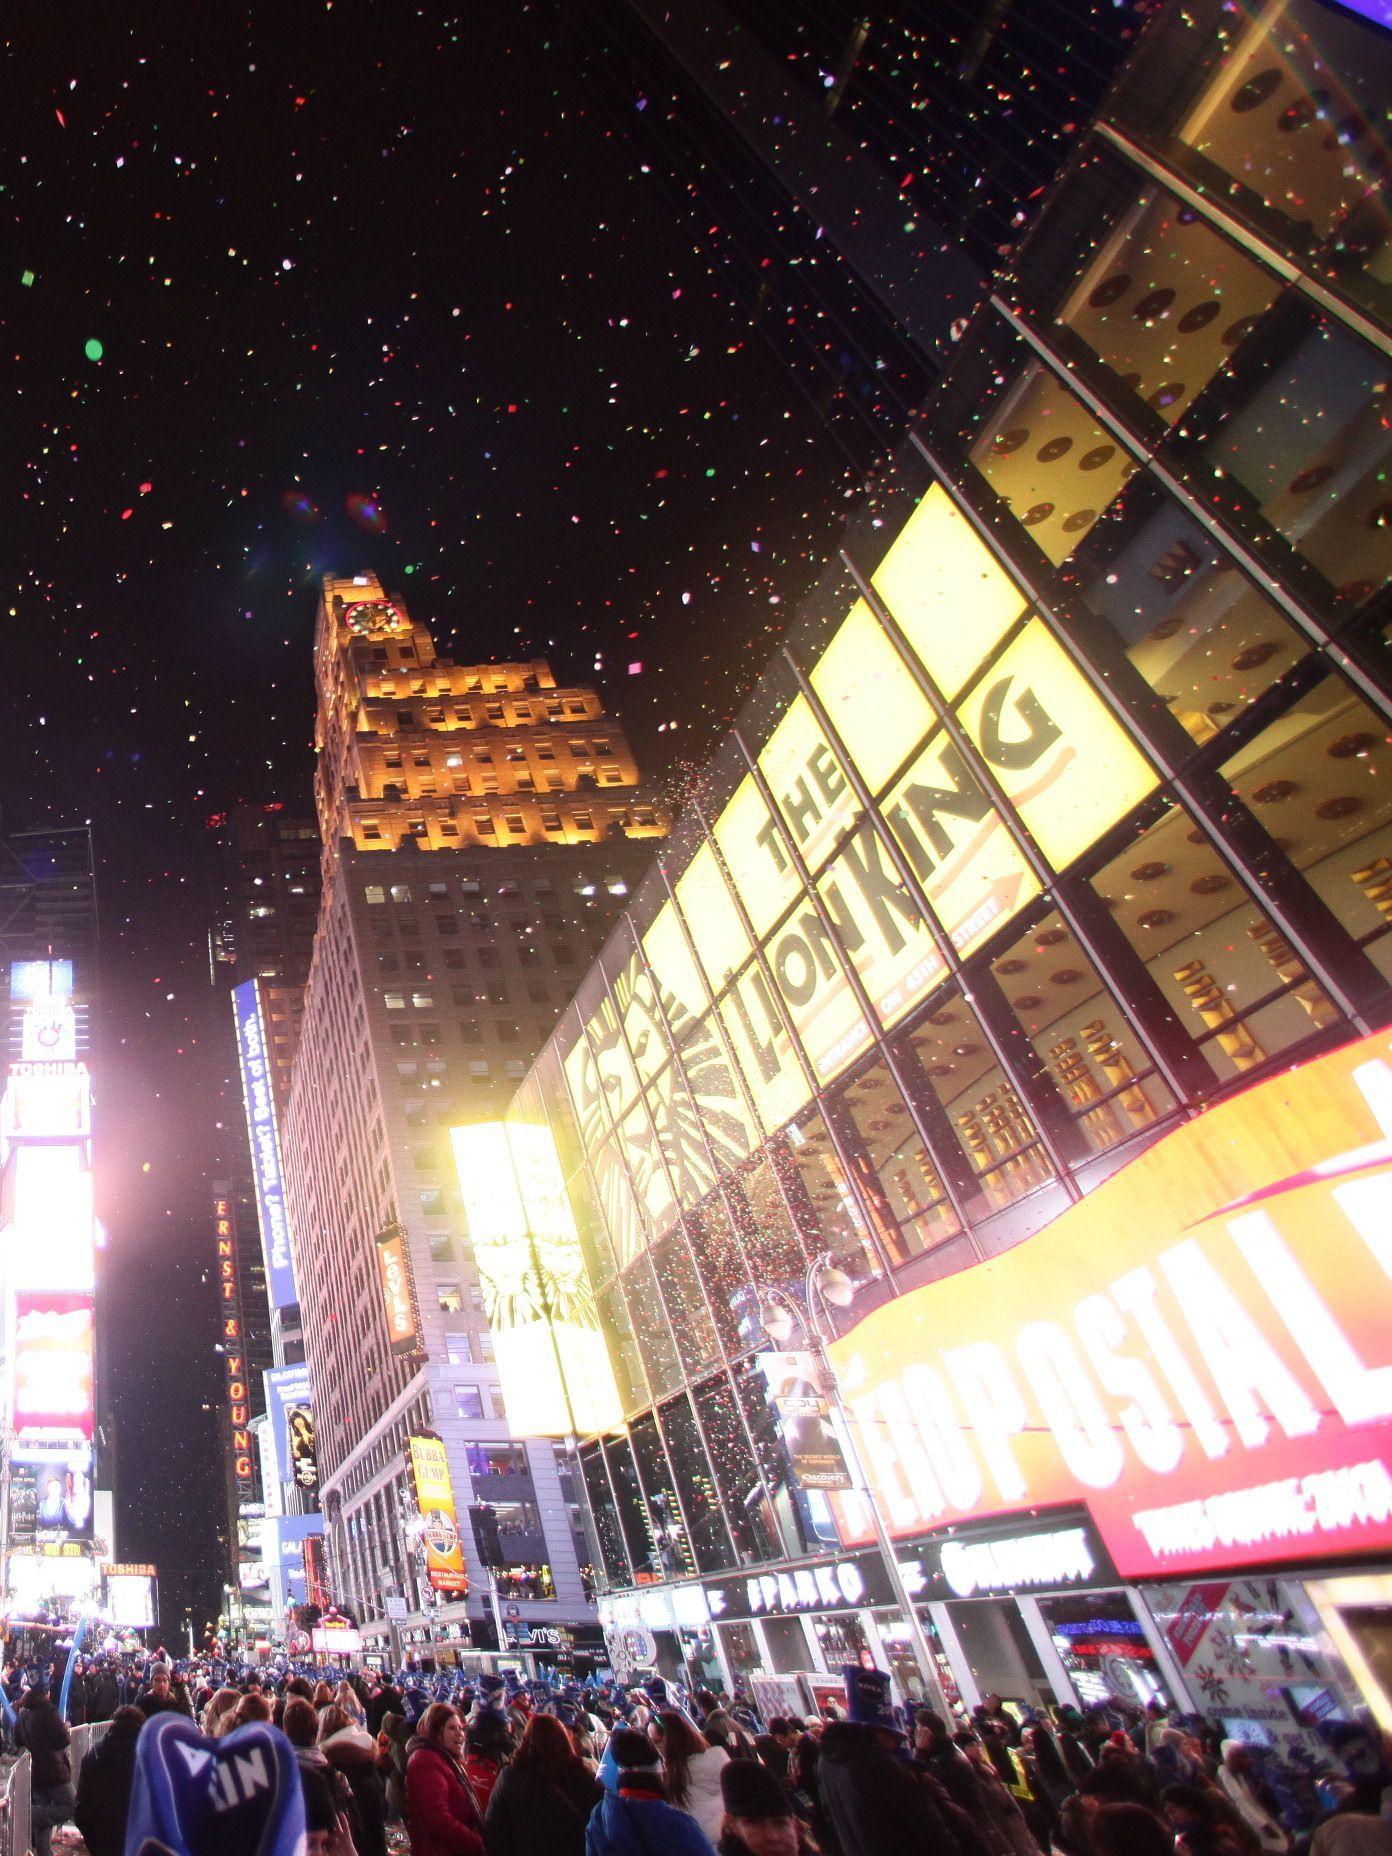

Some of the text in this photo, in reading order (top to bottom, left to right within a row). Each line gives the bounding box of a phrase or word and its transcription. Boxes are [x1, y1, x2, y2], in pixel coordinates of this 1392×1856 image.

[756, 742, 848, 874] THE
[723, 673, 1064, 1085] LION KING
[950, 895, 1001, 949] STREET
[8, 1062, 89, 1075] TOSHIBA
[243, 1012, 289, 1269] Phone? Tablet? Best of both.
[217, 1200, 235, 1298] ERNST
[225, 1319, 238, 1337] &
[227, 1357, 250, 1477] YOUNG
[412, 1443, 445, 1463] BUBBA
[418, 1464, 445, 1481] GUMP
[102, 1563, 157, 1577] TOSHIBA
[437, 1579, 461, 1588] MARKET
